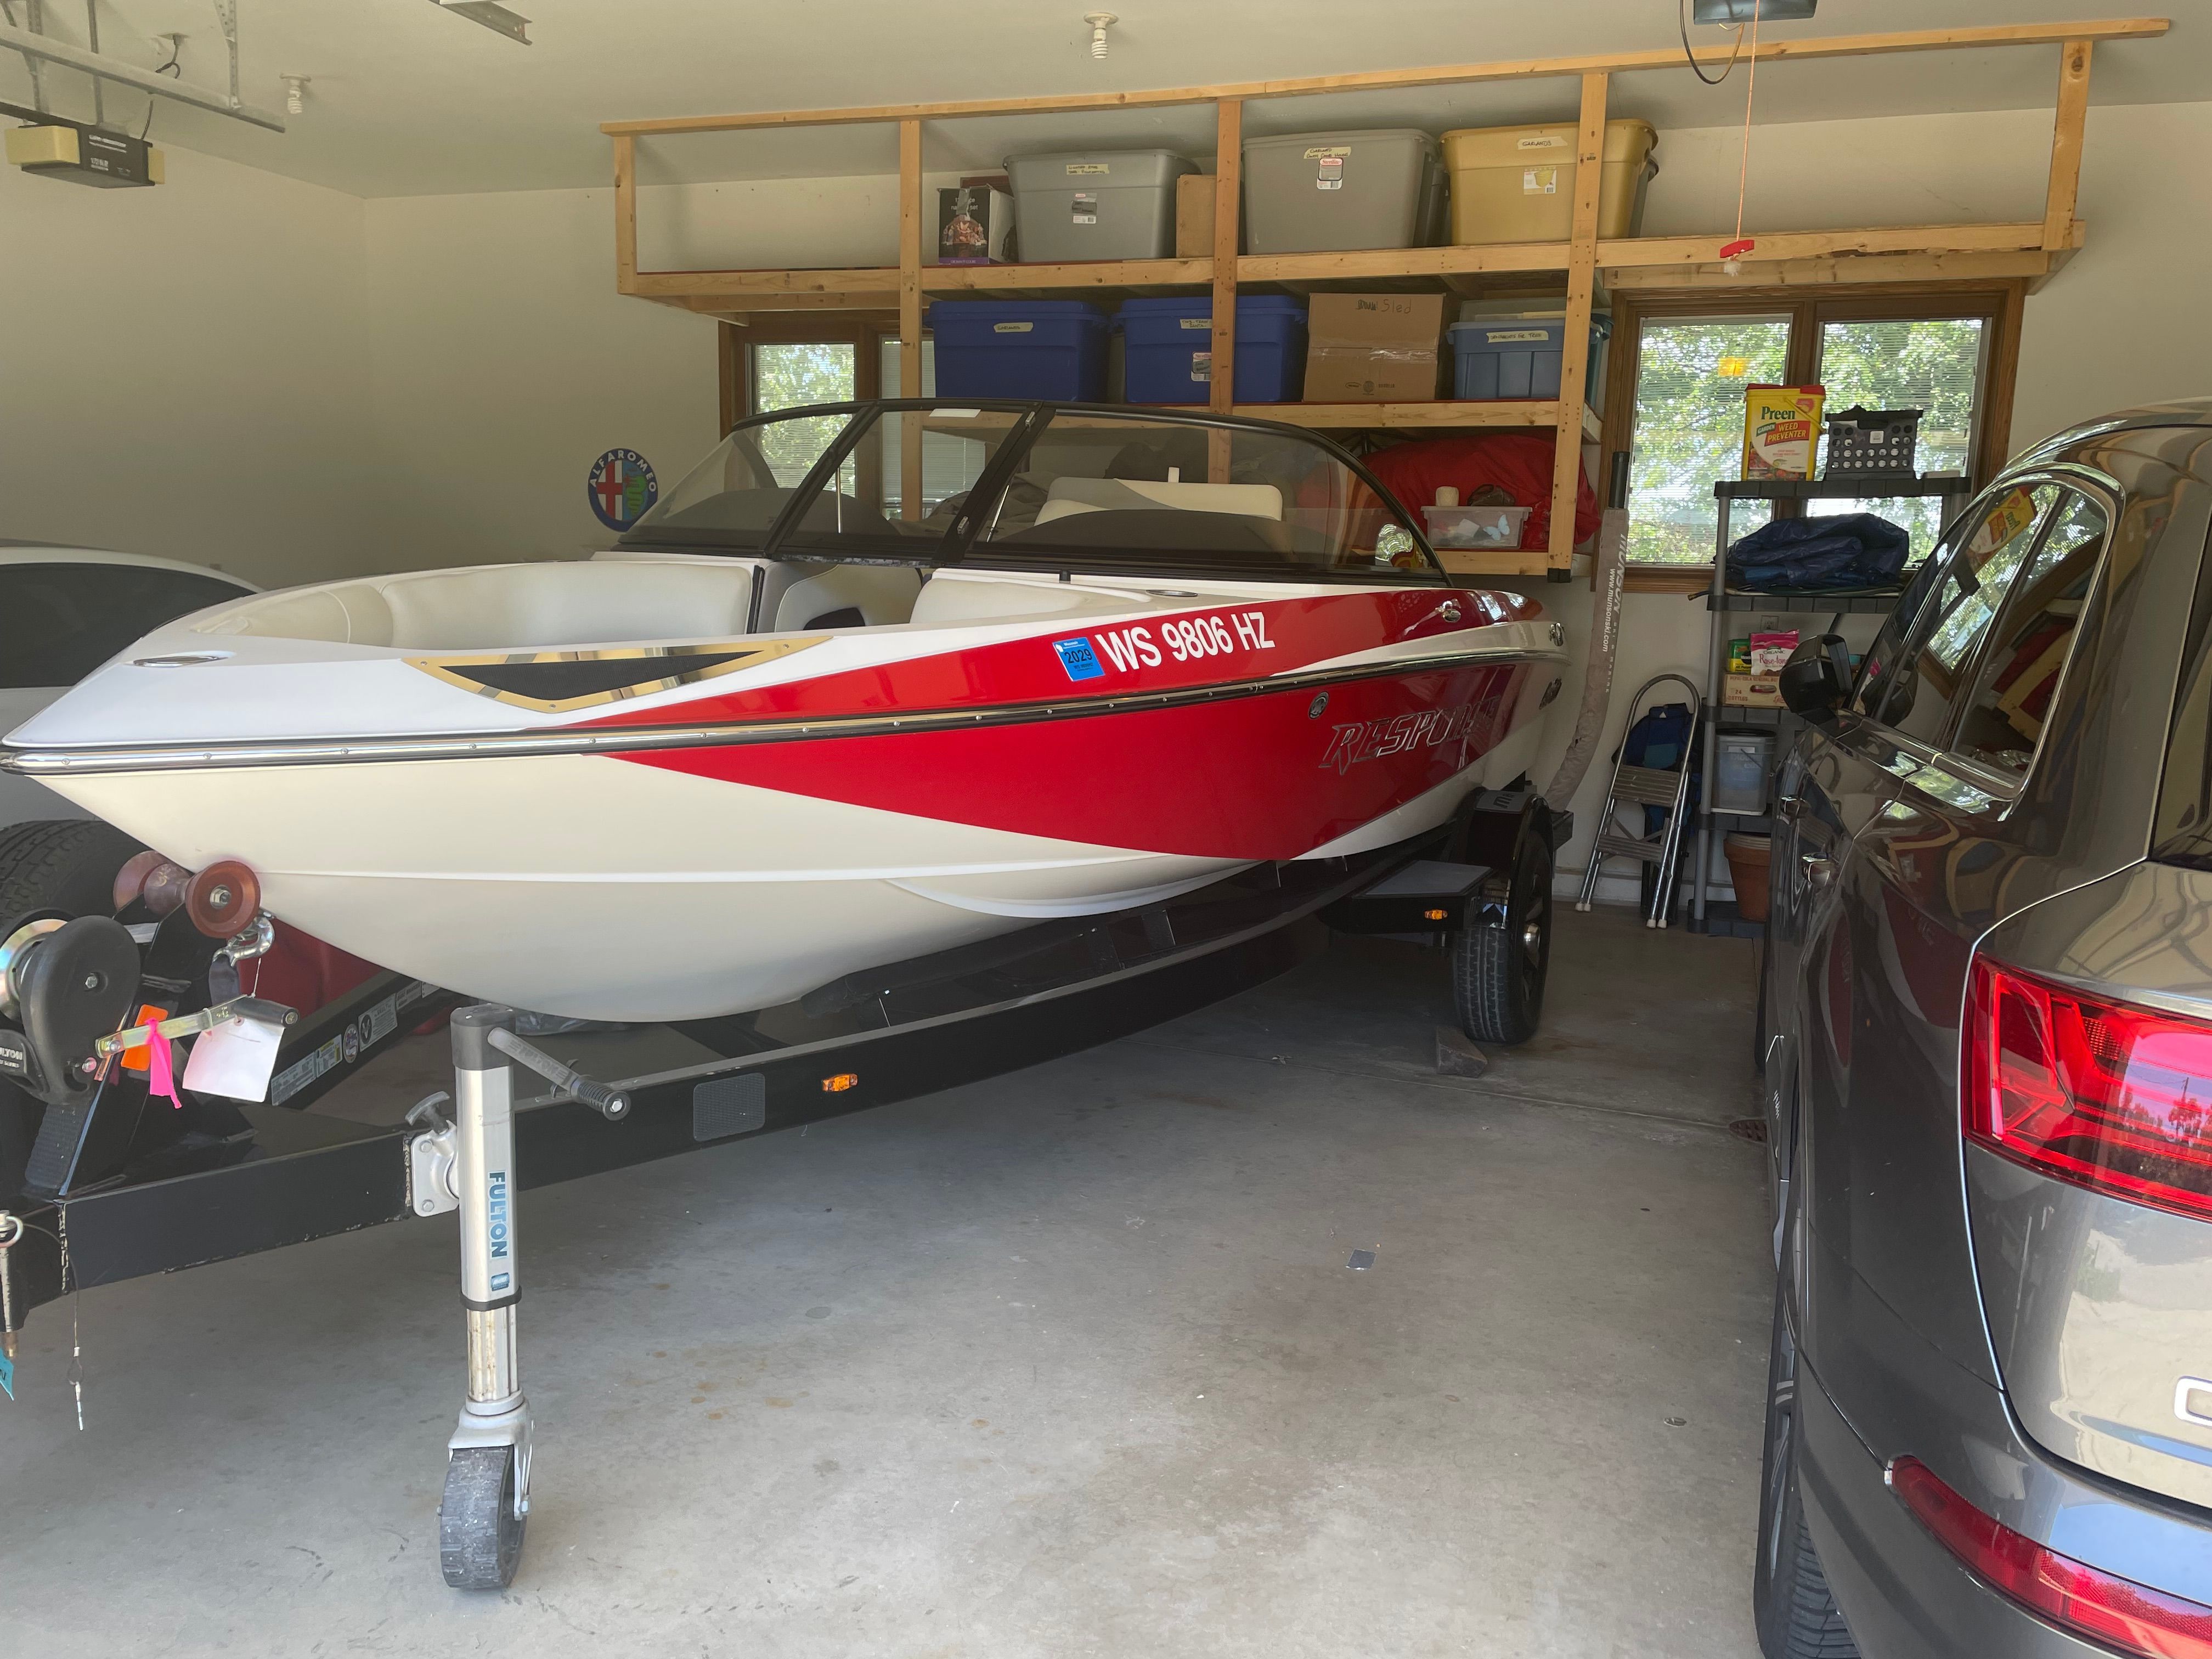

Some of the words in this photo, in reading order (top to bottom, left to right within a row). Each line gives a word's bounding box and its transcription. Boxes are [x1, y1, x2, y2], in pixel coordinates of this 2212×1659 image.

[1381, 298, 1412, 314] Sled
[1761, 406, 1795, 420] Preen
[1779, 422, 1798, 432] WEED
[1768, 430, 1806, 442] PREVENTER
[1613, 533, 1627, 614] MUNSON
[1602, 568, 1616, 652] www.munsonski.com
[1094, 627, 1162, 673] WS
[1161, 616, 1233, 661] 9806
[1231, 612, 1276, 650] HZ
[1064, 649, 1093, 664] 2029
[489, 1172, 507, 1258] FULTON
